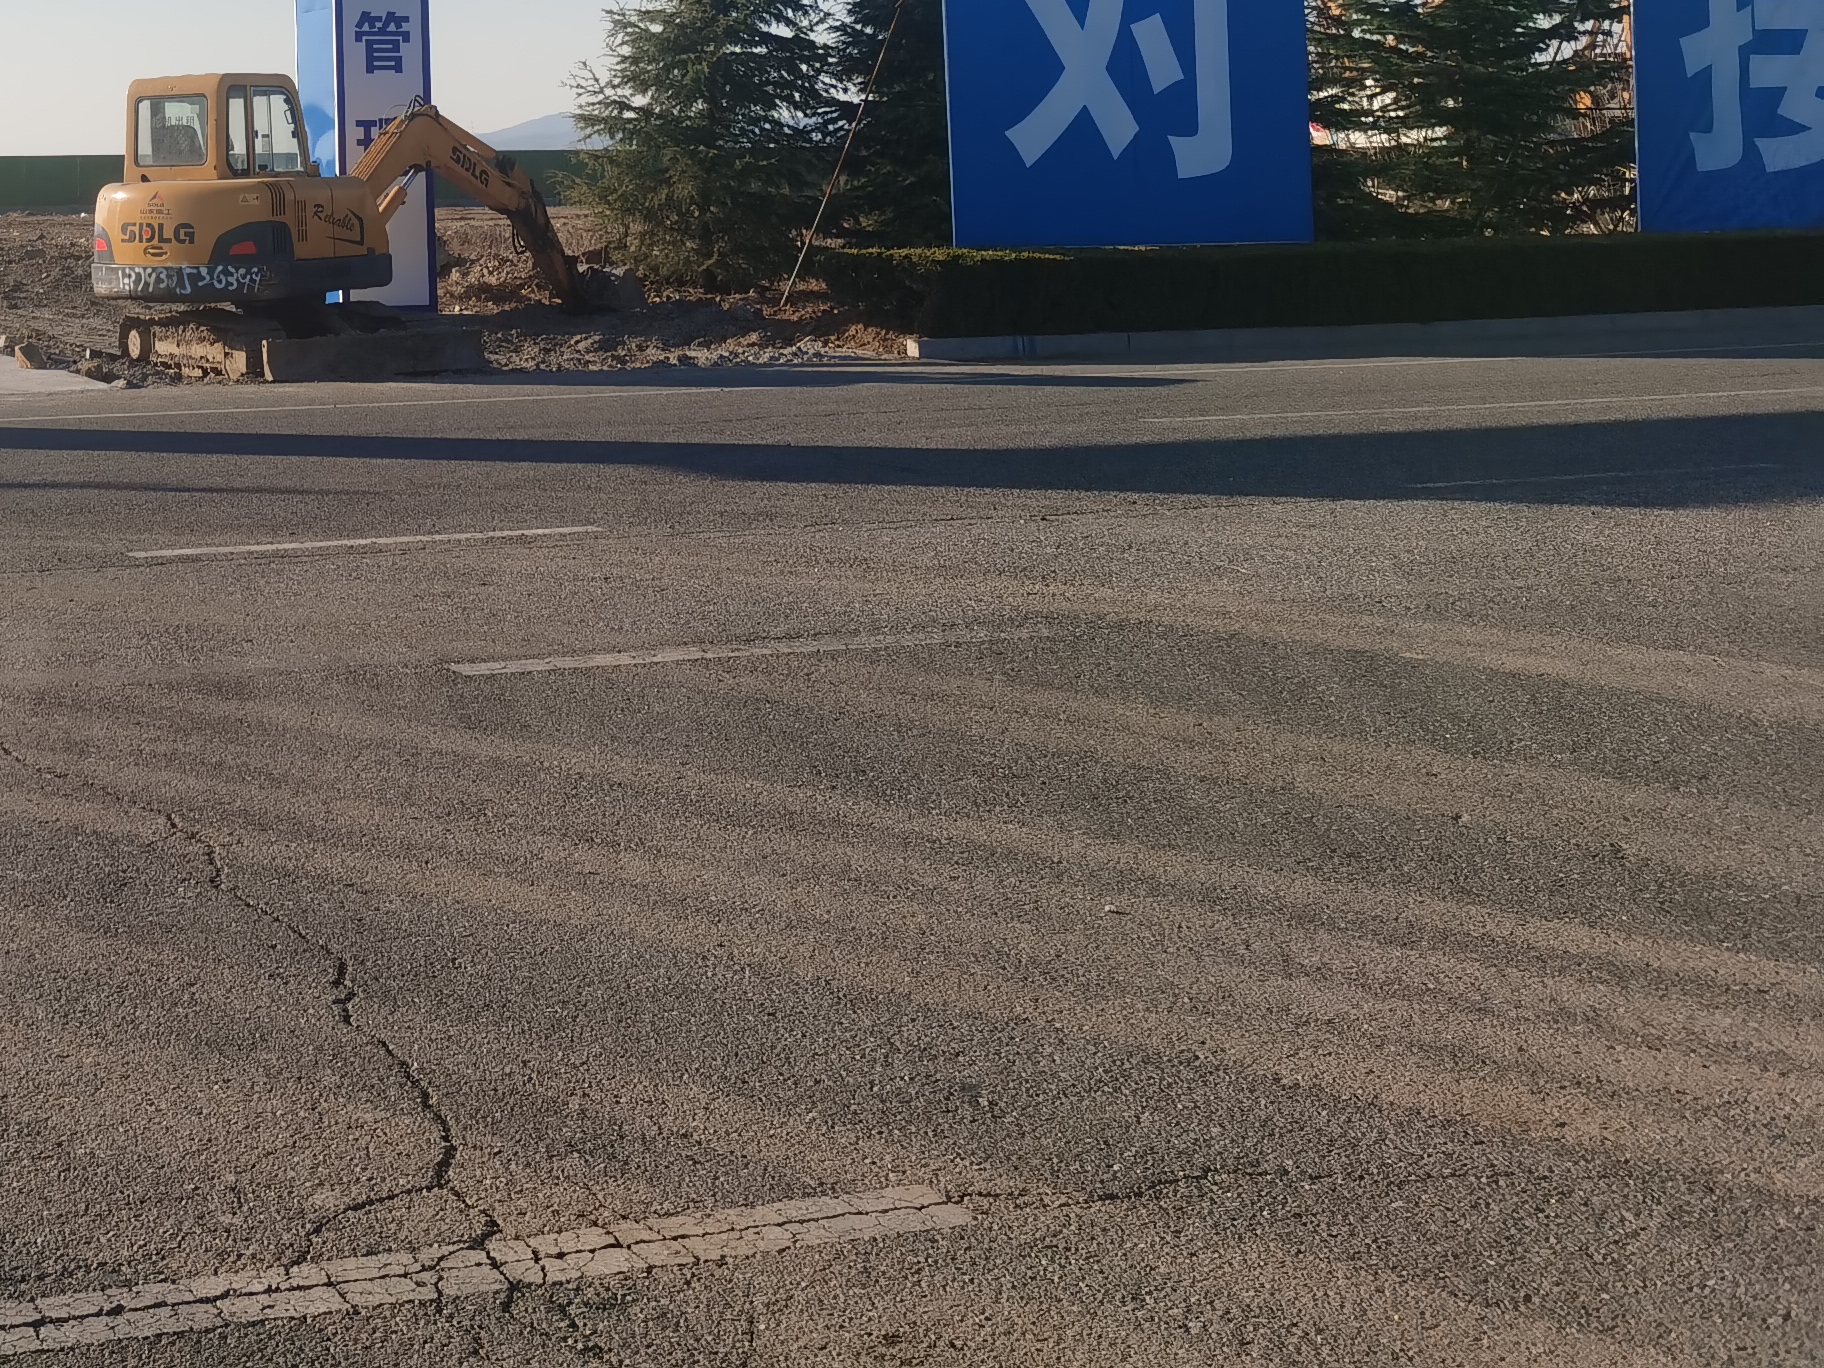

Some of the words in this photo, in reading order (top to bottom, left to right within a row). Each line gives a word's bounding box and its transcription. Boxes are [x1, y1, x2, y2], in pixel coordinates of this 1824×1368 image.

[449, 145, 490, 189] SDLG
[312, 203, 355, 232] Reliable
[120, 221, 195, 244] SDLG
